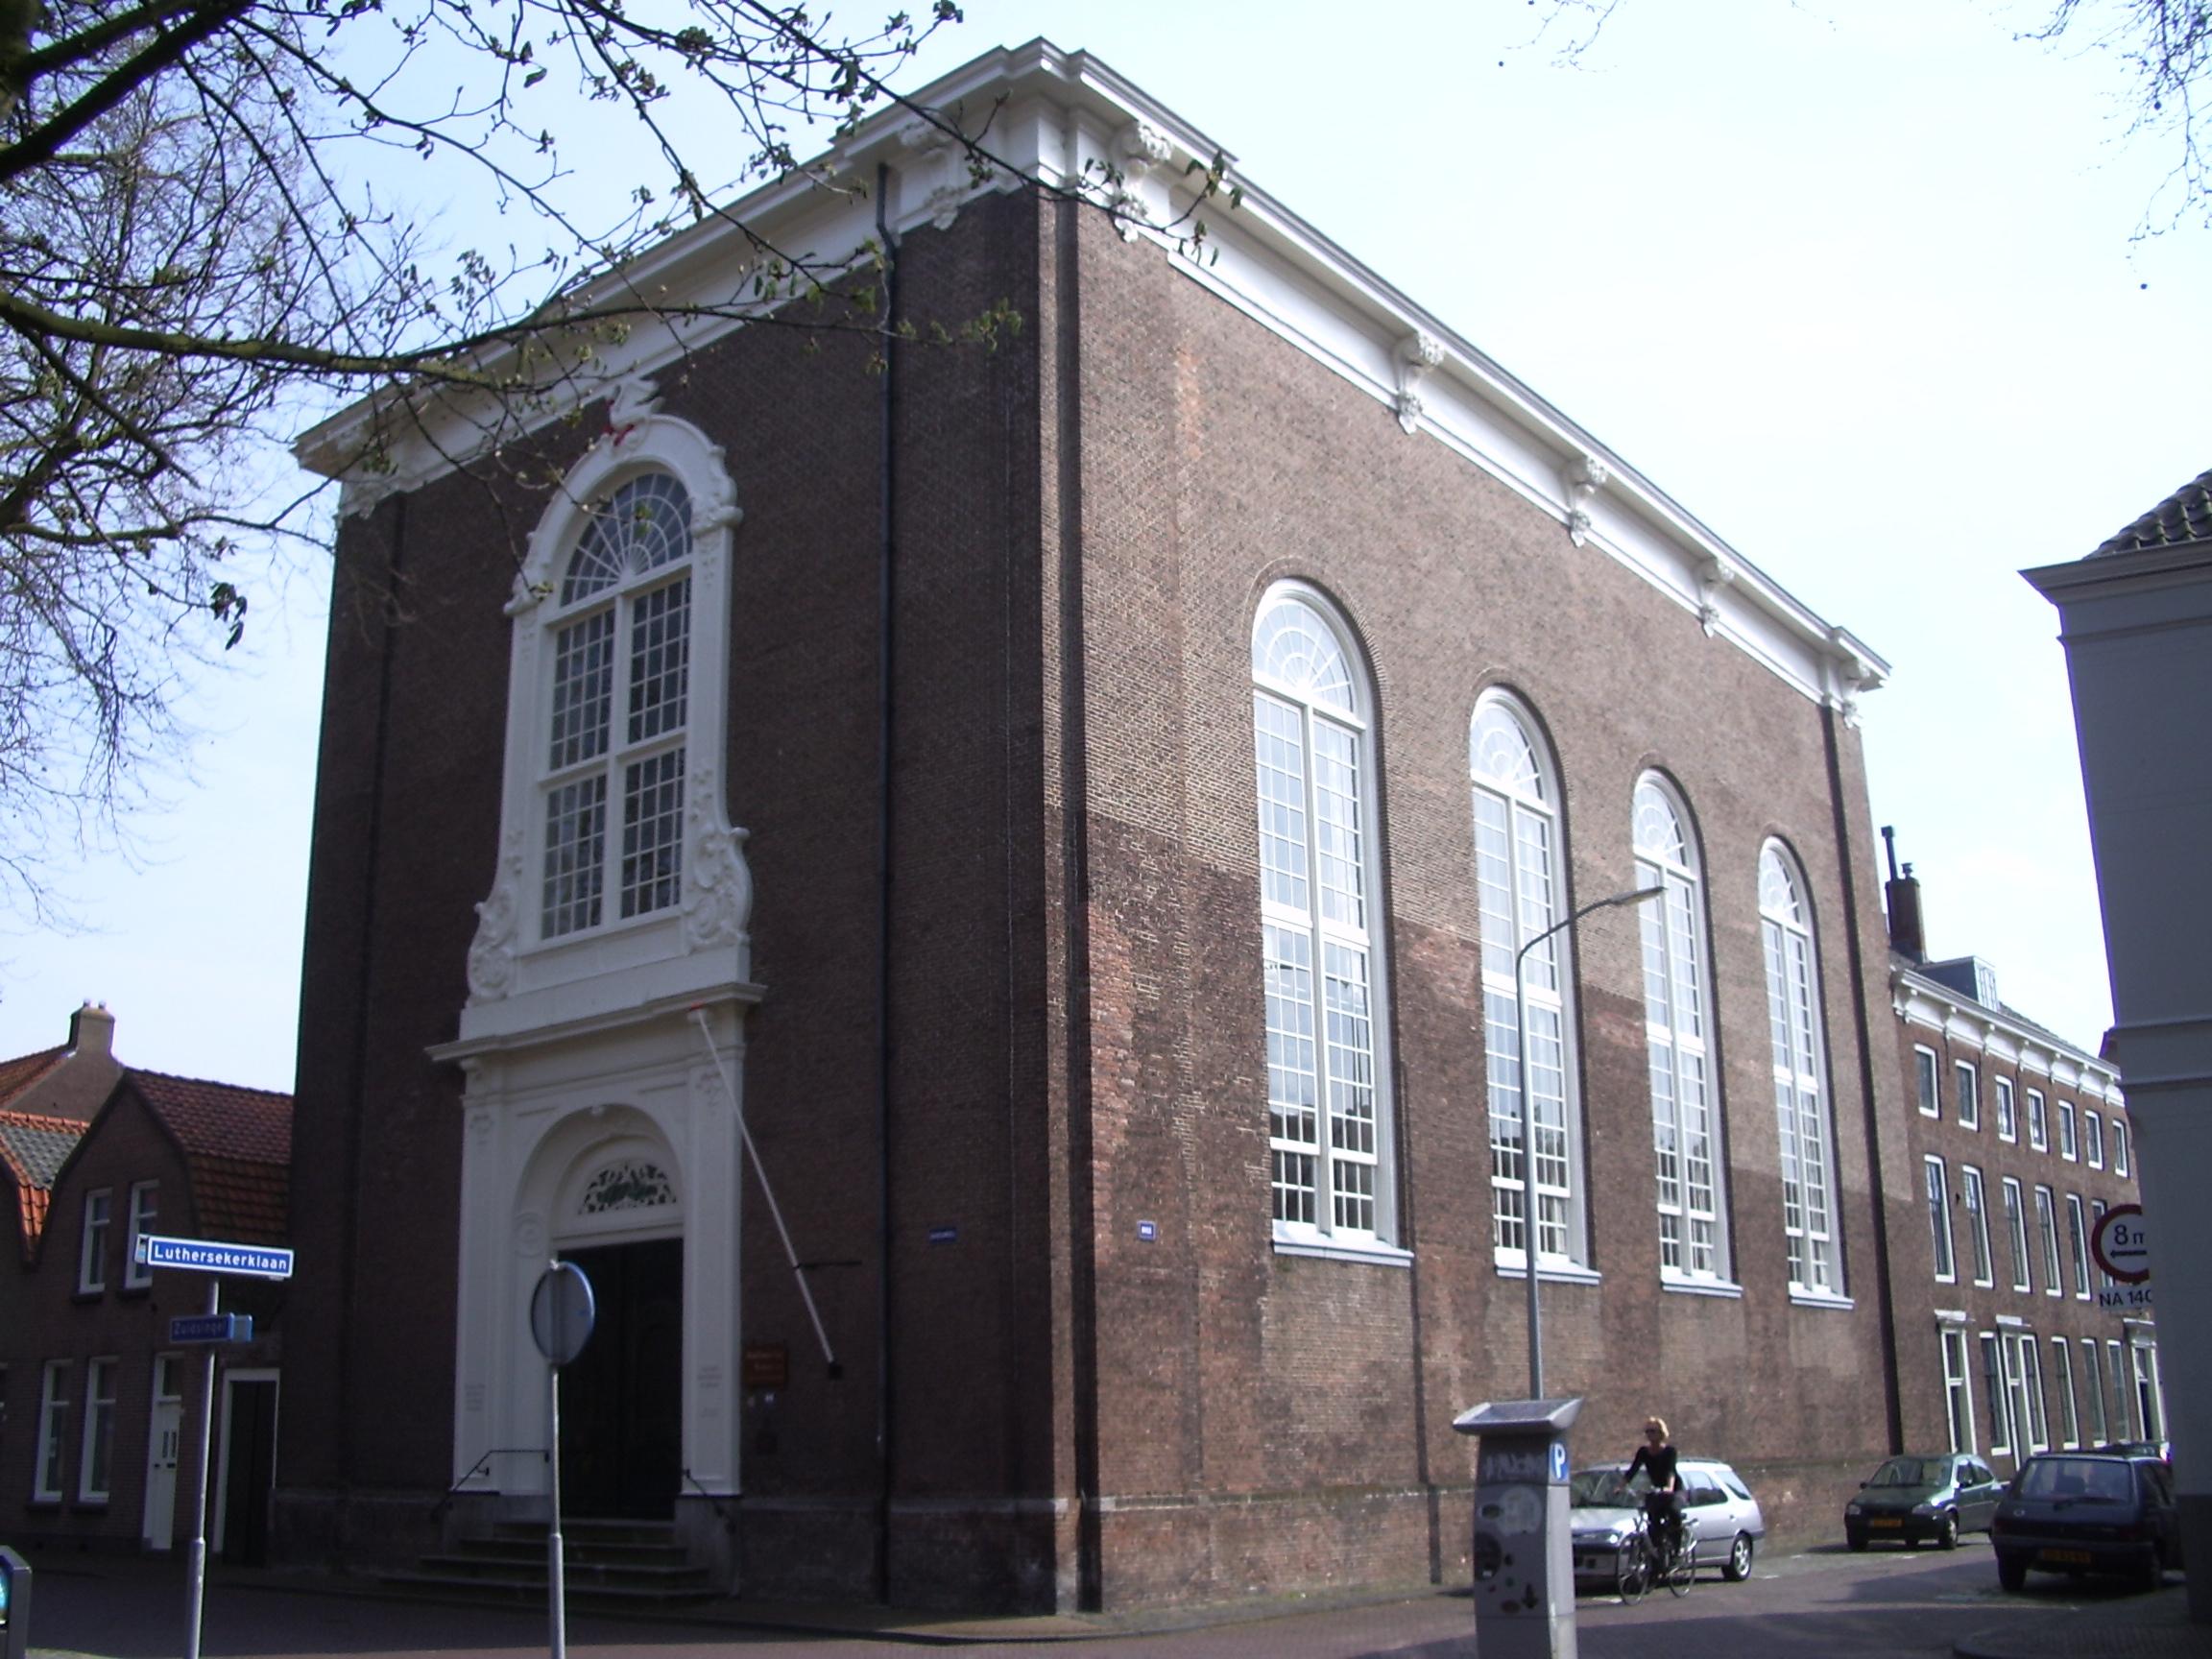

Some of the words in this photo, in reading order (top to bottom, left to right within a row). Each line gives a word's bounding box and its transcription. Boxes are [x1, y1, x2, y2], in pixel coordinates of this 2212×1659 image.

[155, 1245, 287, 1269] Luthersekerklaan
[2099, 1292, 2124, 1308] NA
[1554, 1443, 1565, 1479] P
